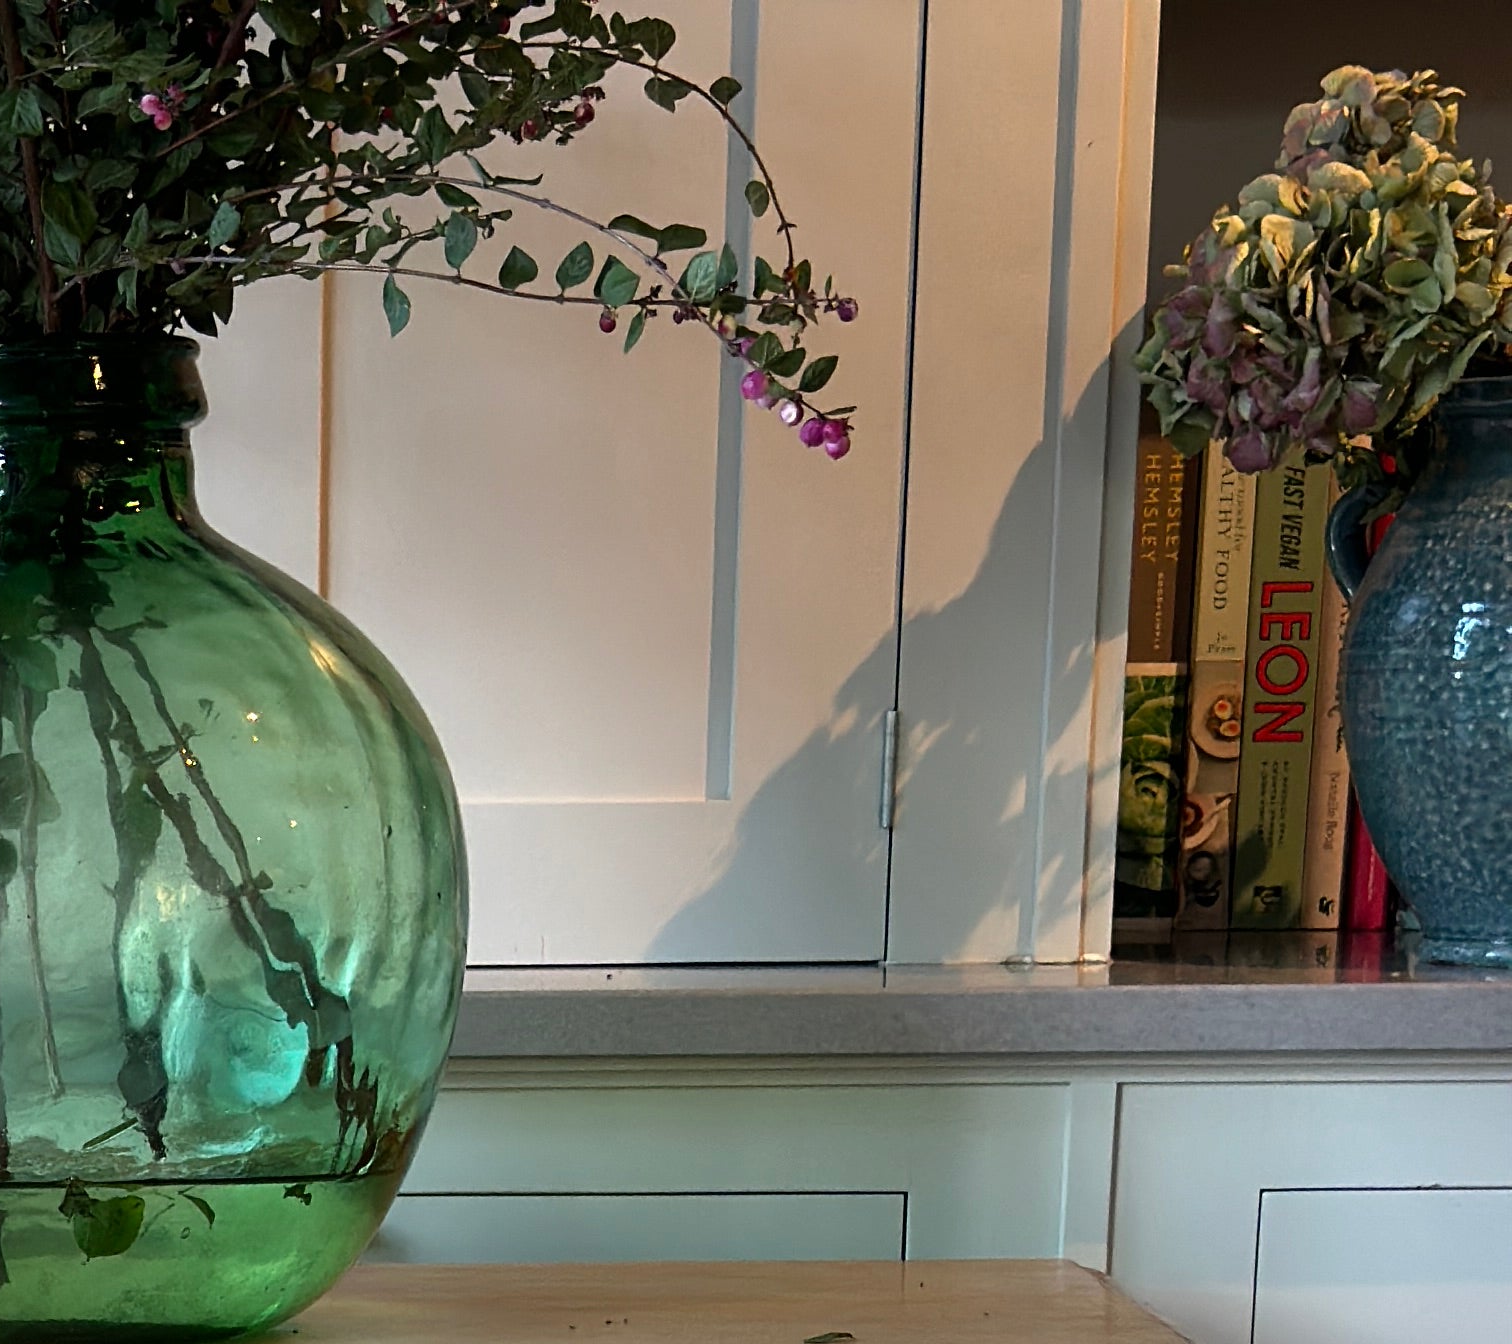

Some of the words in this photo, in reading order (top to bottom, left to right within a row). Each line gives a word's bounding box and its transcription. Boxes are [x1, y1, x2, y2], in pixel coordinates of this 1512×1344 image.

[1140, 453, 1162, 563] HEMSLEY
[1165, 453, 1185, 562] HEMSLEY
[1282, 466, 1306, 511] FAST
[1213, 550, 1230, 610] FOOD
[1279, 514, 1305, 571] VEGAN
[1252, 581, 1314, 743] LEON
